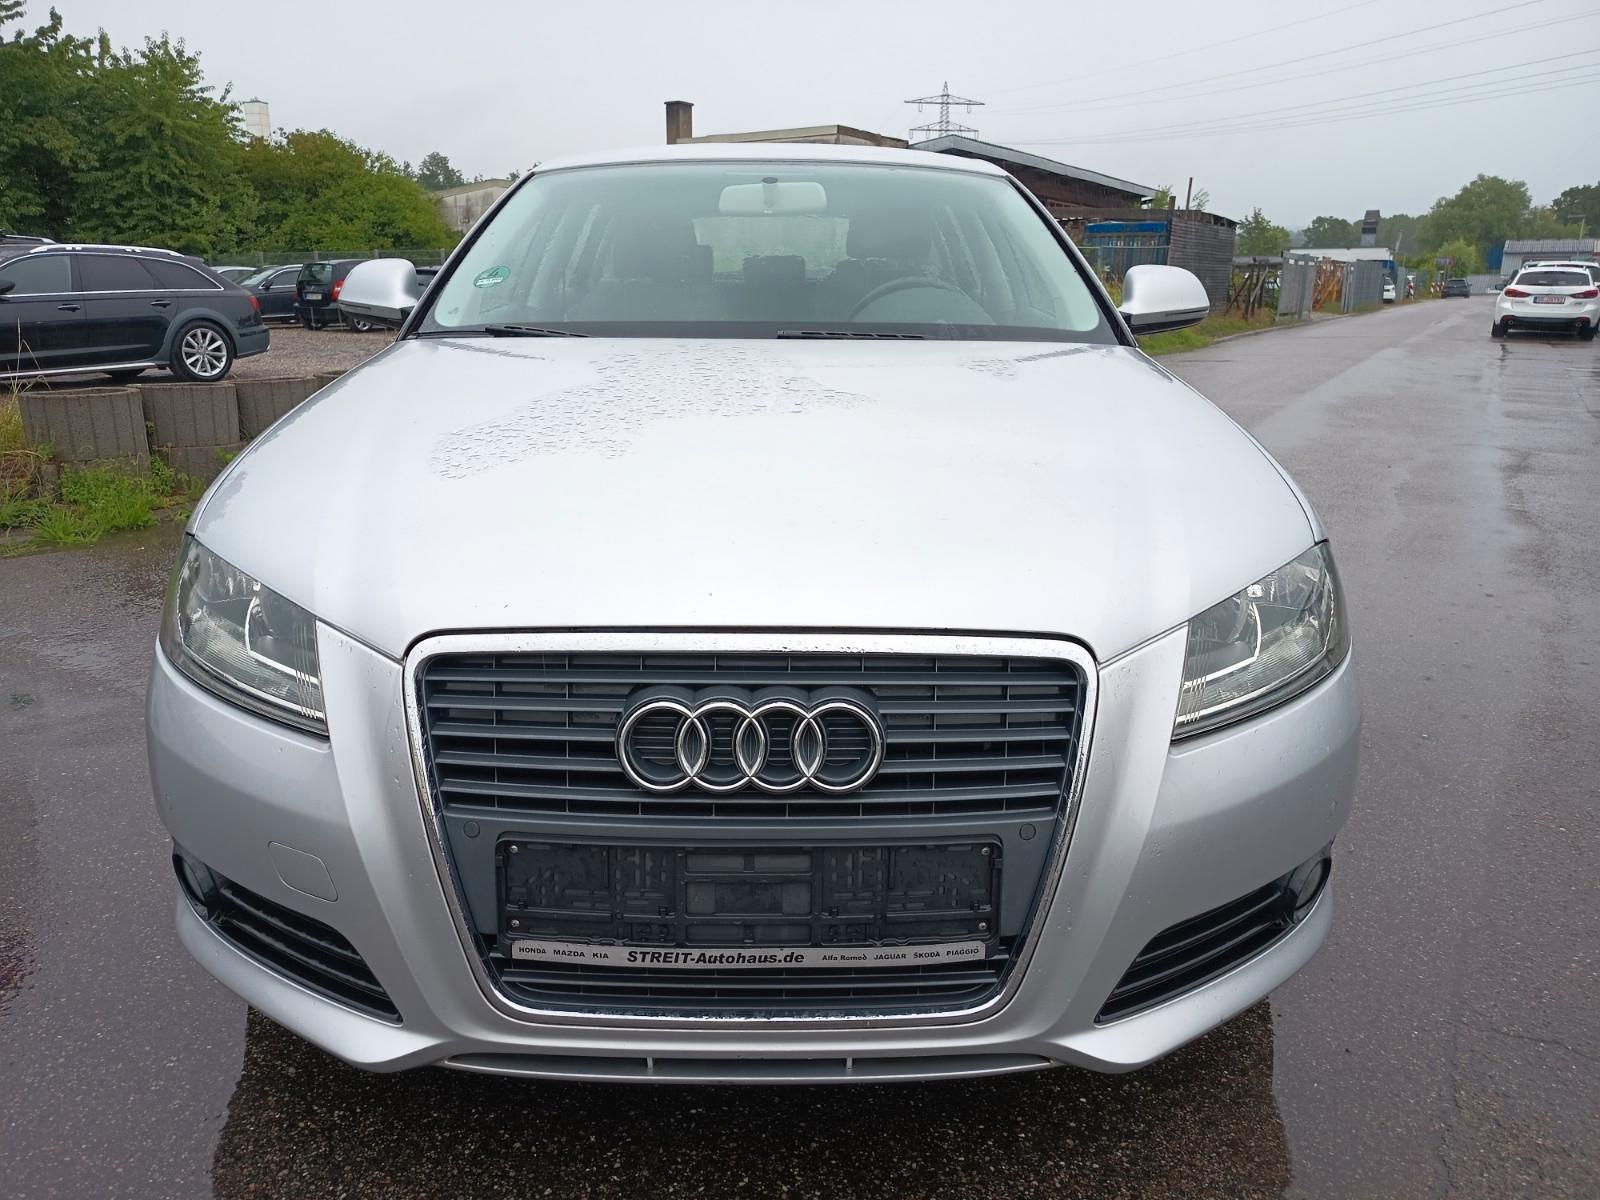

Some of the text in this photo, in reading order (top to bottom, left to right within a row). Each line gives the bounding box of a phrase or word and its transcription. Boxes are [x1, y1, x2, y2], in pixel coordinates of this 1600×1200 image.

[518, 946, 547, 955] HONDA
[553, 949, 586, 958] MAZDA
[626, 950, 805, 965] STREIT-Autohaus.de
[946, 947, 979, 957] PIAGGIO
